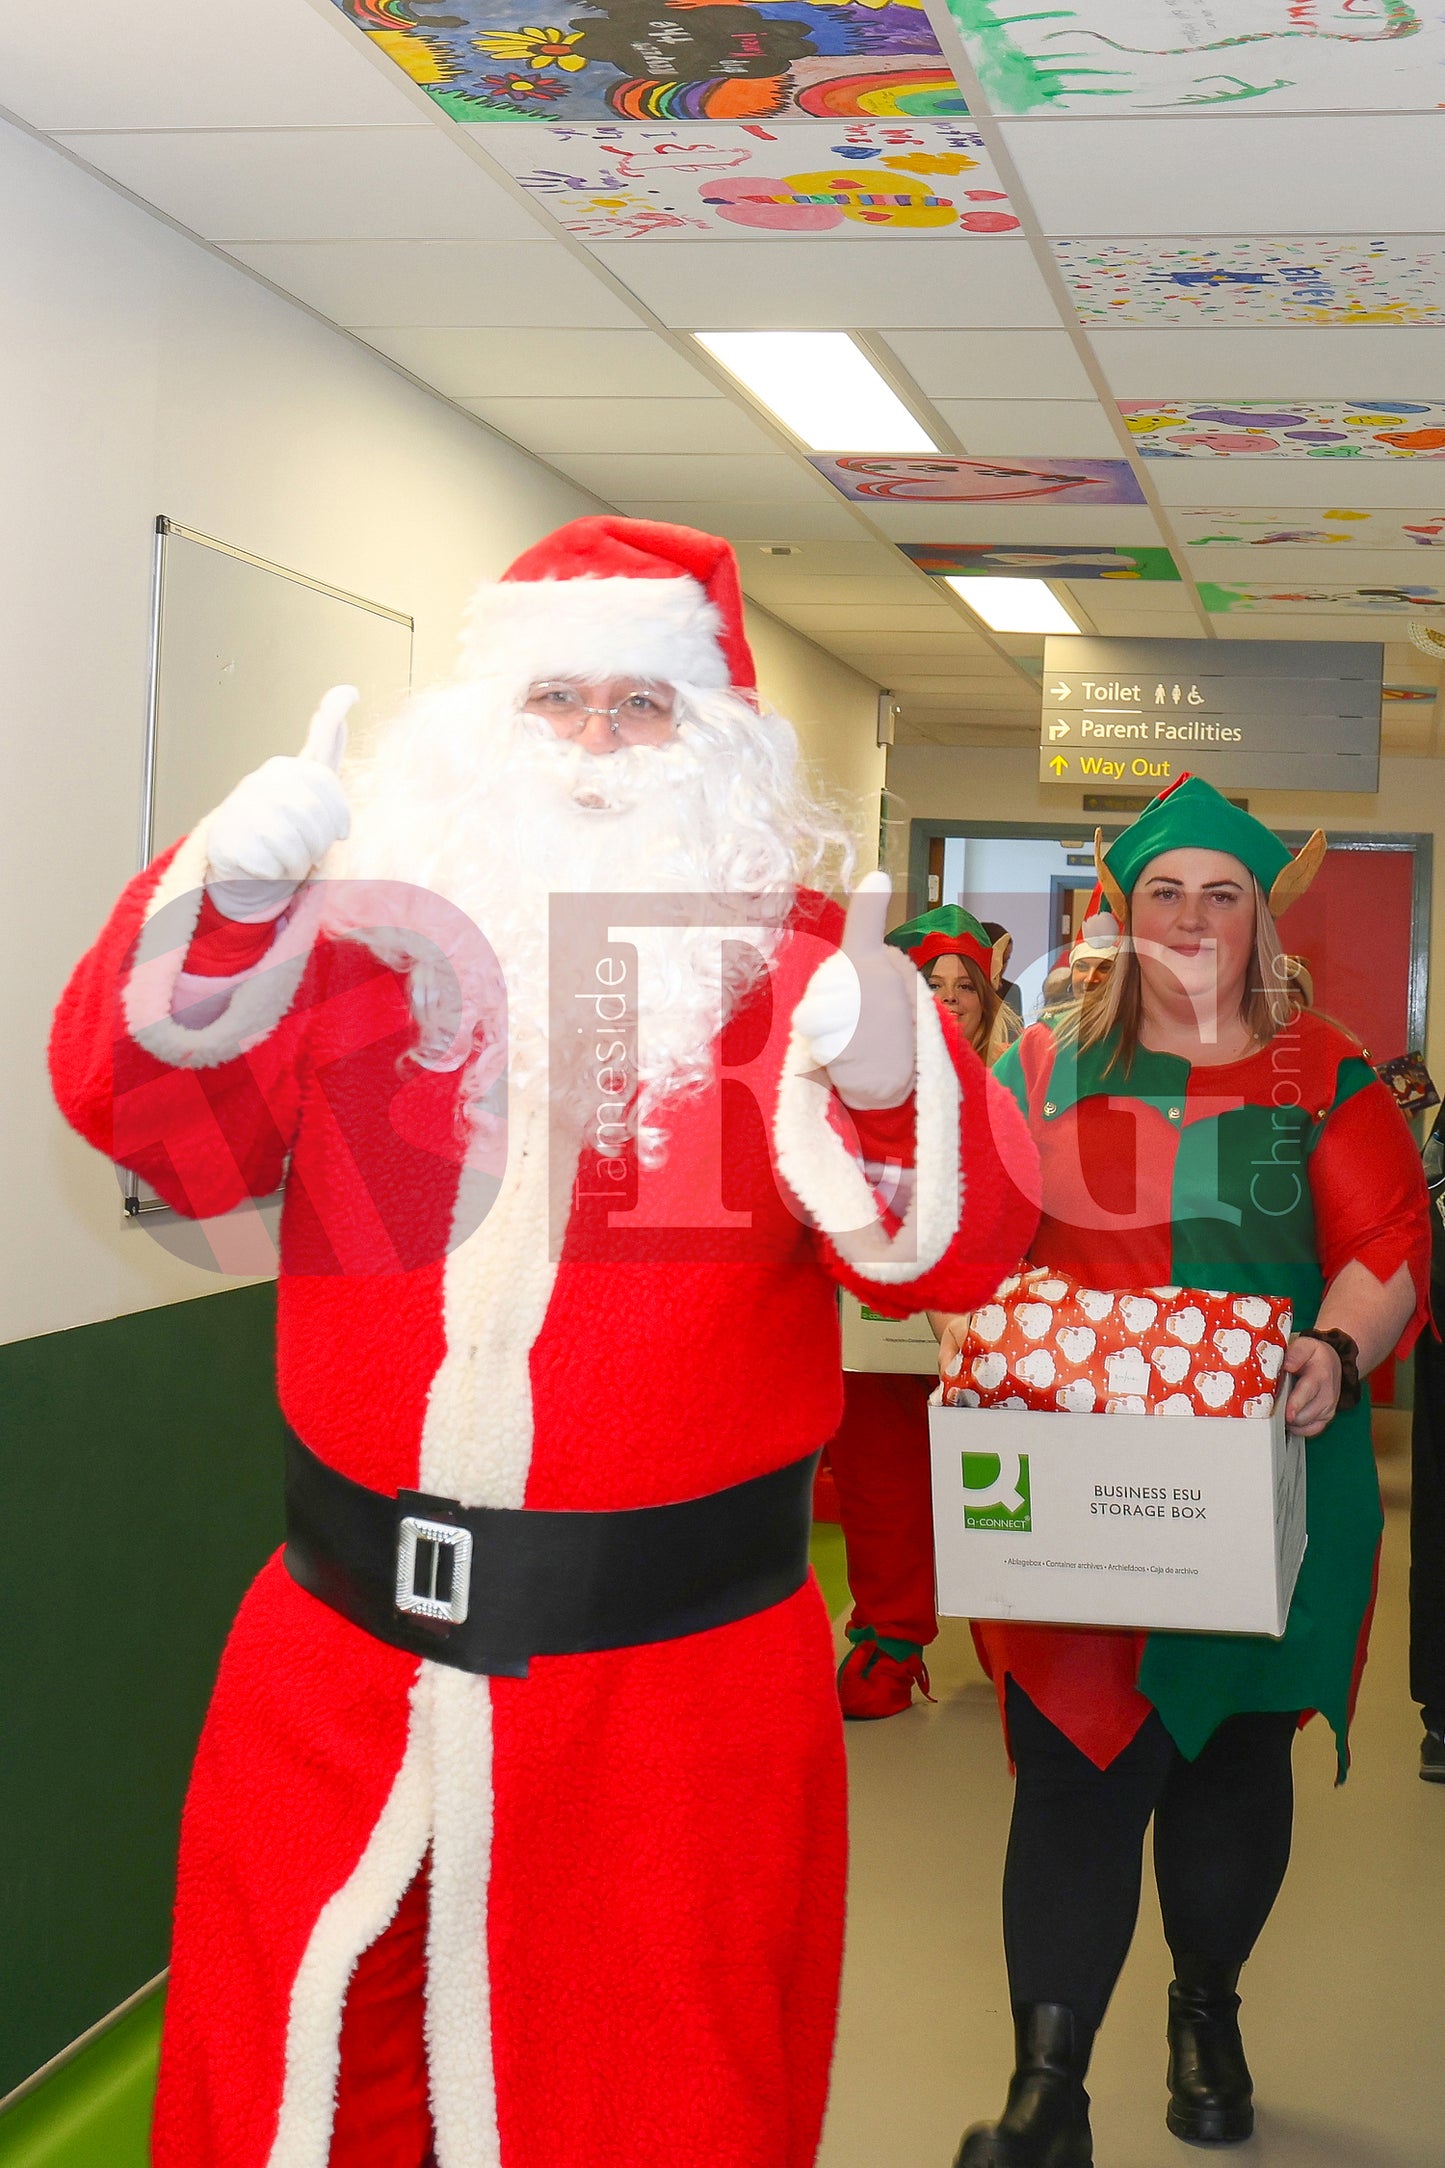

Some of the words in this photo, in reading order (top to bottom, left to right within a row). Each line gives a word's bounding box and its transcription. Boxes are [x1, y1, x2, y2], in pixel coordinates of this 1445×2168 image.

[1081, 682, 1141, 701] Toilet
[1081, 719, 1149, 739] Parent
[1154, 721, 1242, 741] Facilities
[1080, 757, 1126, 780] Way
[1131, 758, 1171, 777] Out
[1094, 1485, 1167, 1500] BUSINESS
[1173, 1488, 1201, 1501] ESU
[1090, 1502, 1165, 1517] STORAGE
[1171, 1506, 1207, 1519] BOX
[1046, 1560, 1076, 1569] Container
[1078, 1562, 1103, 1570] archives
[1150, 1566, 1164, 1574] Caja
[1165, 1566, 1174, 1574] de
